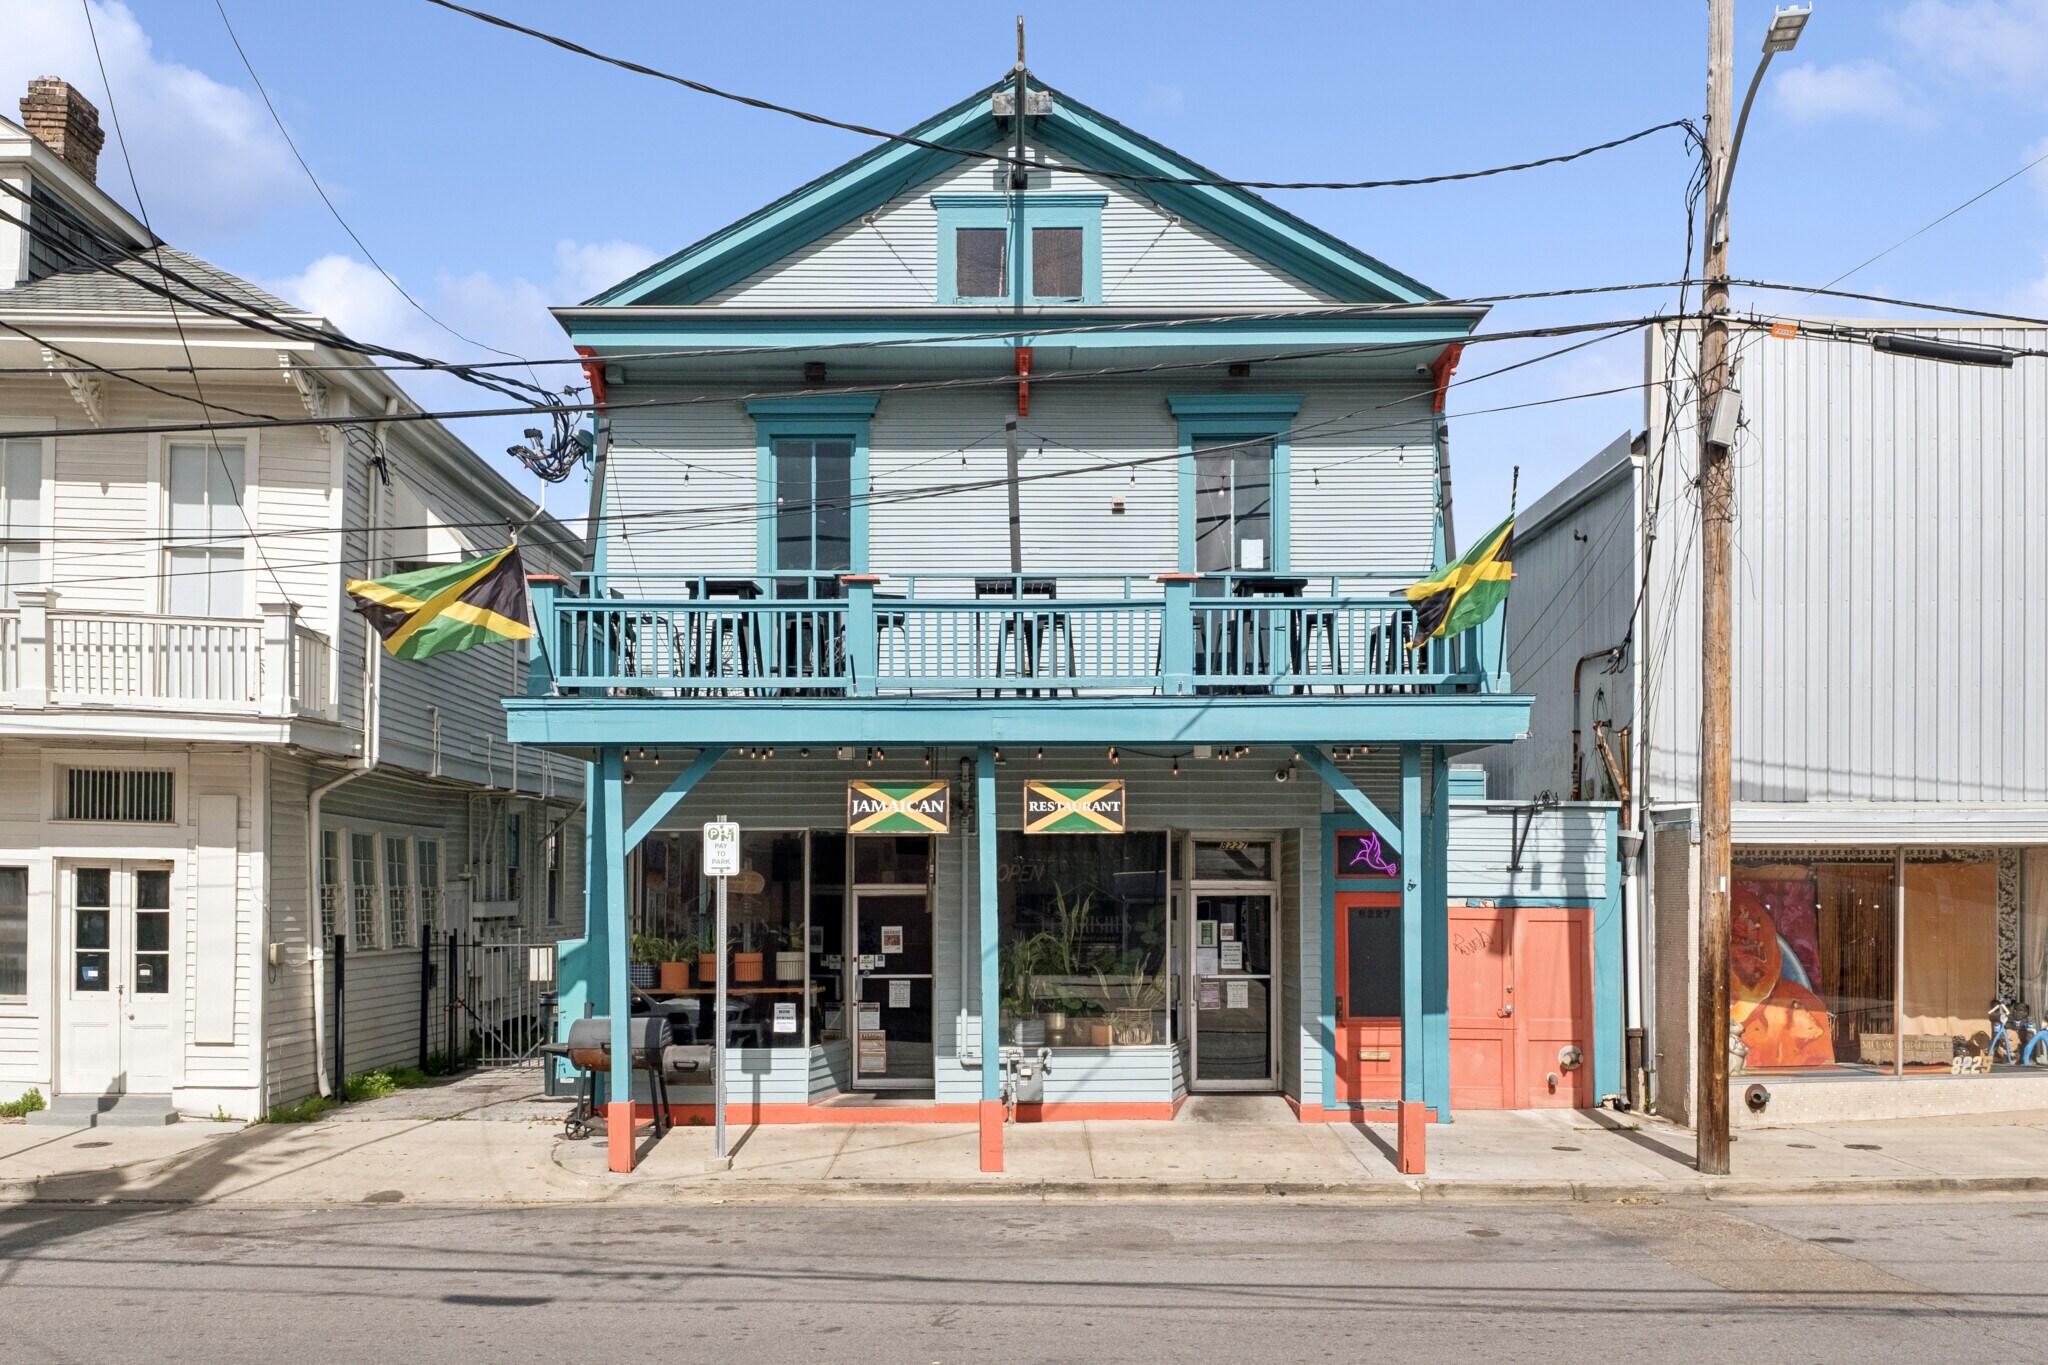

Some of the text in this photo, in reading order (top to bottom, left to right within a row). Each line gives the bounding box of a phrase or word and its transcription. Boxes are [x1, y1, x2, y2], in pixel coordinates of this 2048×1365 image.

[852, 800, 945, 815] JAMAICAN
[1028, 801, 1120, 812] RESTAURANT
[1220, 841, 1248, 850] 8227
[998, 864, 1045, 882] OPEN
[1951, 1056, 1991, 1074] 8225
